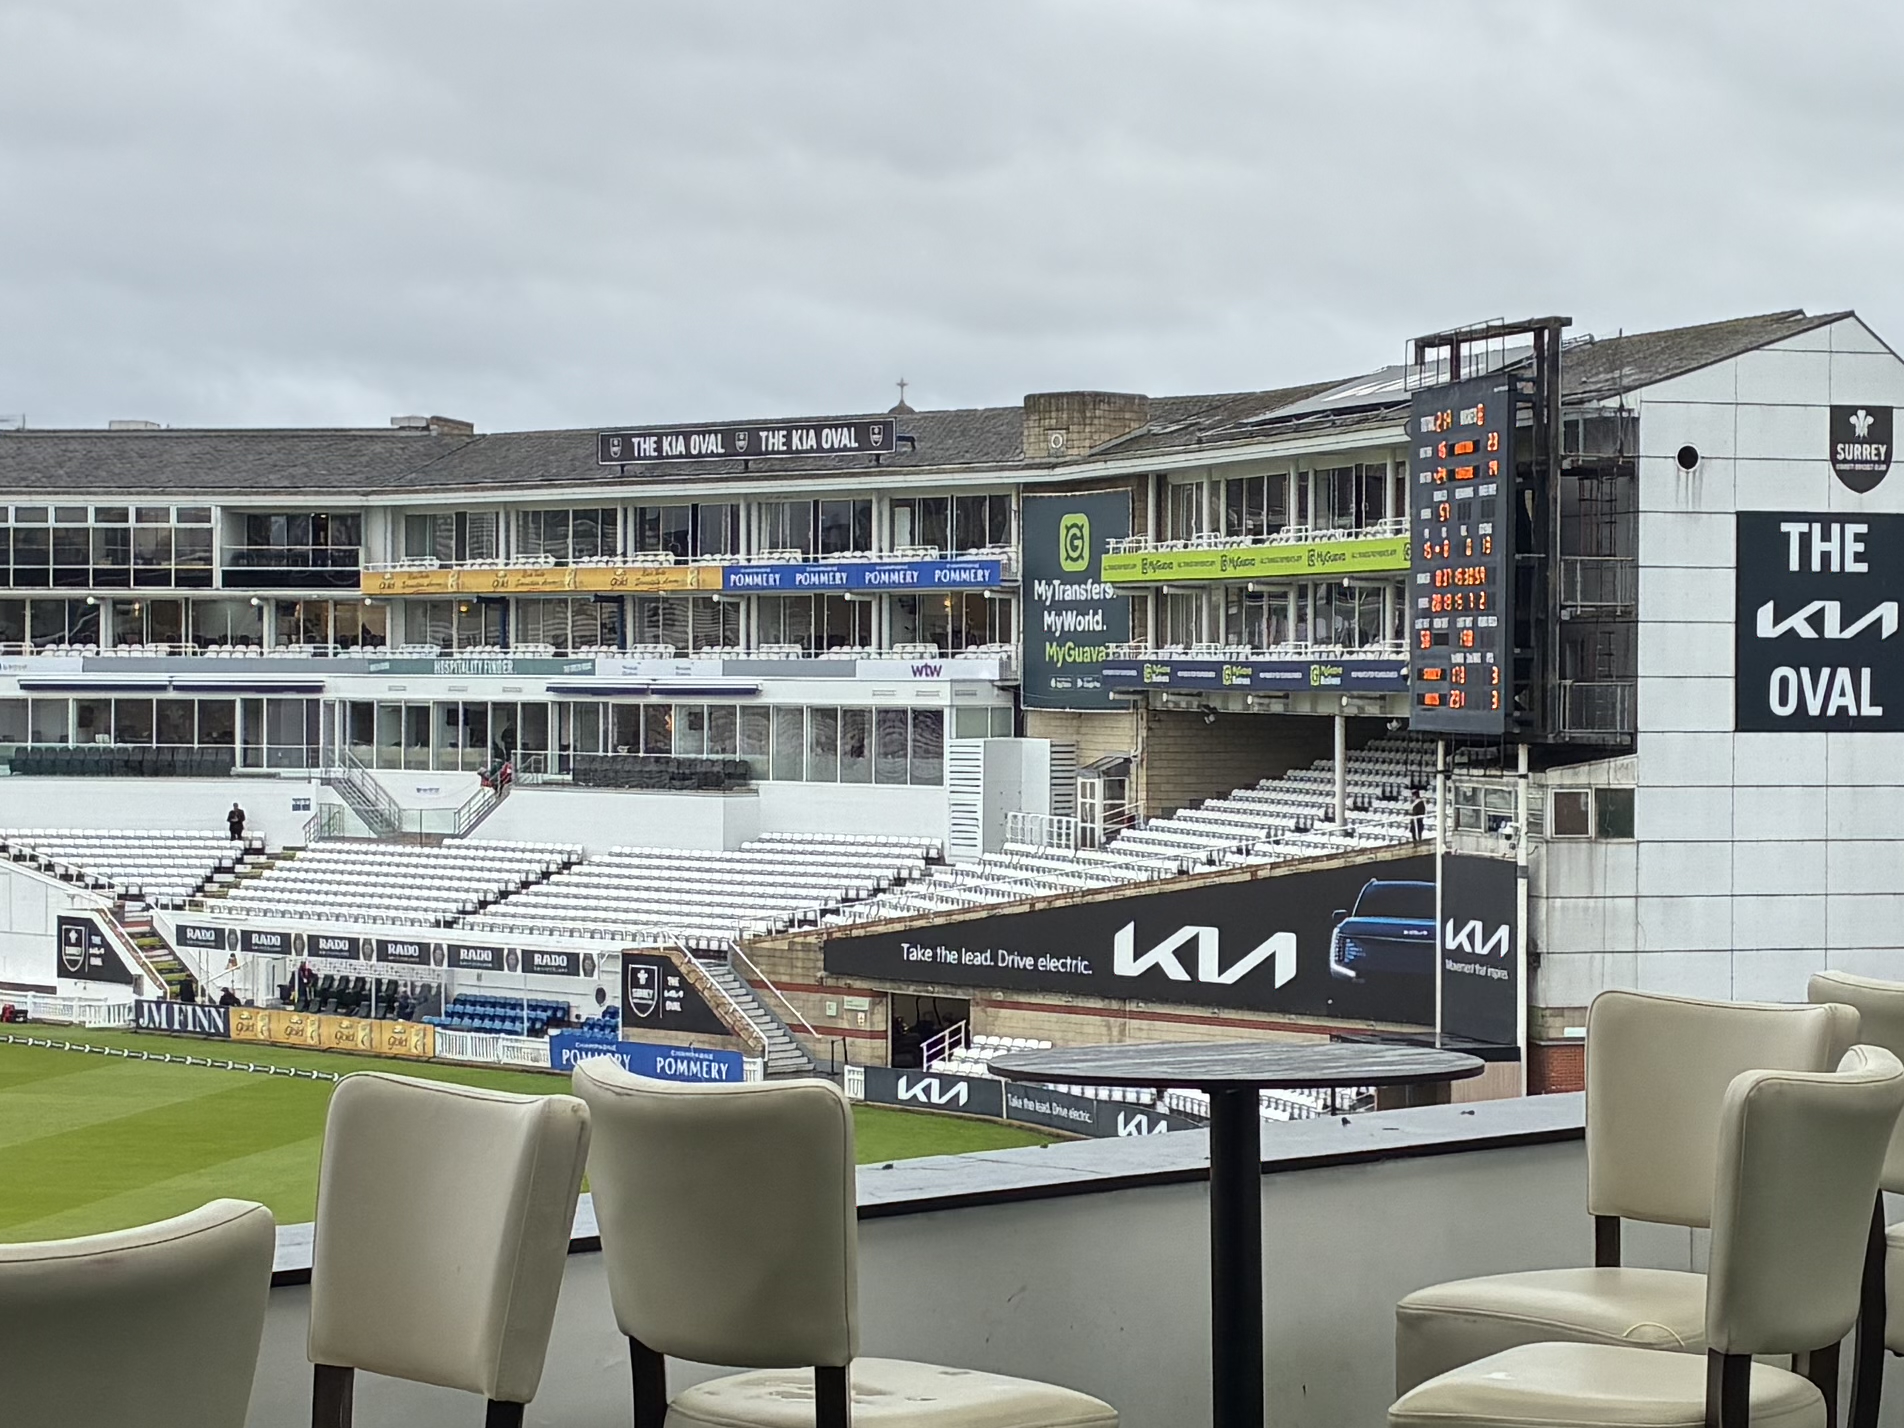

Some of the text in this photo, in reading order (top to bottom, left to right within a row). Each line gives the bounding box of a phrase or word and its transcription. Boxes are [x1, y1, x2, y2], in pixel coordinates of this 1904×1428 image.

[632, 434, 725, 457] THE KIA OVAL
[759, 427, 858, 452] THE KIA OVAL
[1836, 443, 1887, 461] SURREY
[1780, 522, 1868, 573] THE
[730, 573, 781, 587] POMMERY
[796, 573, 847, 585] POMMERY
[865, 570, 919, 584] POMMERY
[934, 568, 991, 583] POMMERY
[1034, 579, 1117, 606] MyTransfers.
[1043, 609, 1107, 637] MyWorld.
[1756, 599, 1899, 641] KIA
[1046, 641, 1106, 667] MyGuava
[911, 663, 942, 677] wtw
[1769, 665, 1883, 717] OVAL
[186, 927, 215, 941] RADO
[251, 933, 281, 946] RADO
[319, 938, 349, 951] RADO
[1445, 918, 1510, 958] KIA
[388, 943, 419, 956] RADO
[460, 948, 492, 961] RADO
[534, 954, 568, 966] RADO
[901, 943, 1092, 975] Take the lead. Drive electric.
[1114, 920, 1297, 989] KIA
[139, 1005, 225, 1034] JM FINN
[656, 1056, 729, 1080] POMMERY
[898, 1075, 968, 1107] KIA
[1007, 1093, 1023, 1109] Take
[1024, 1097, 1034, 1111] the
[1052, 1102, 1068, 1119] Drive
[1068, 1105, 1094, 1124] electric.
